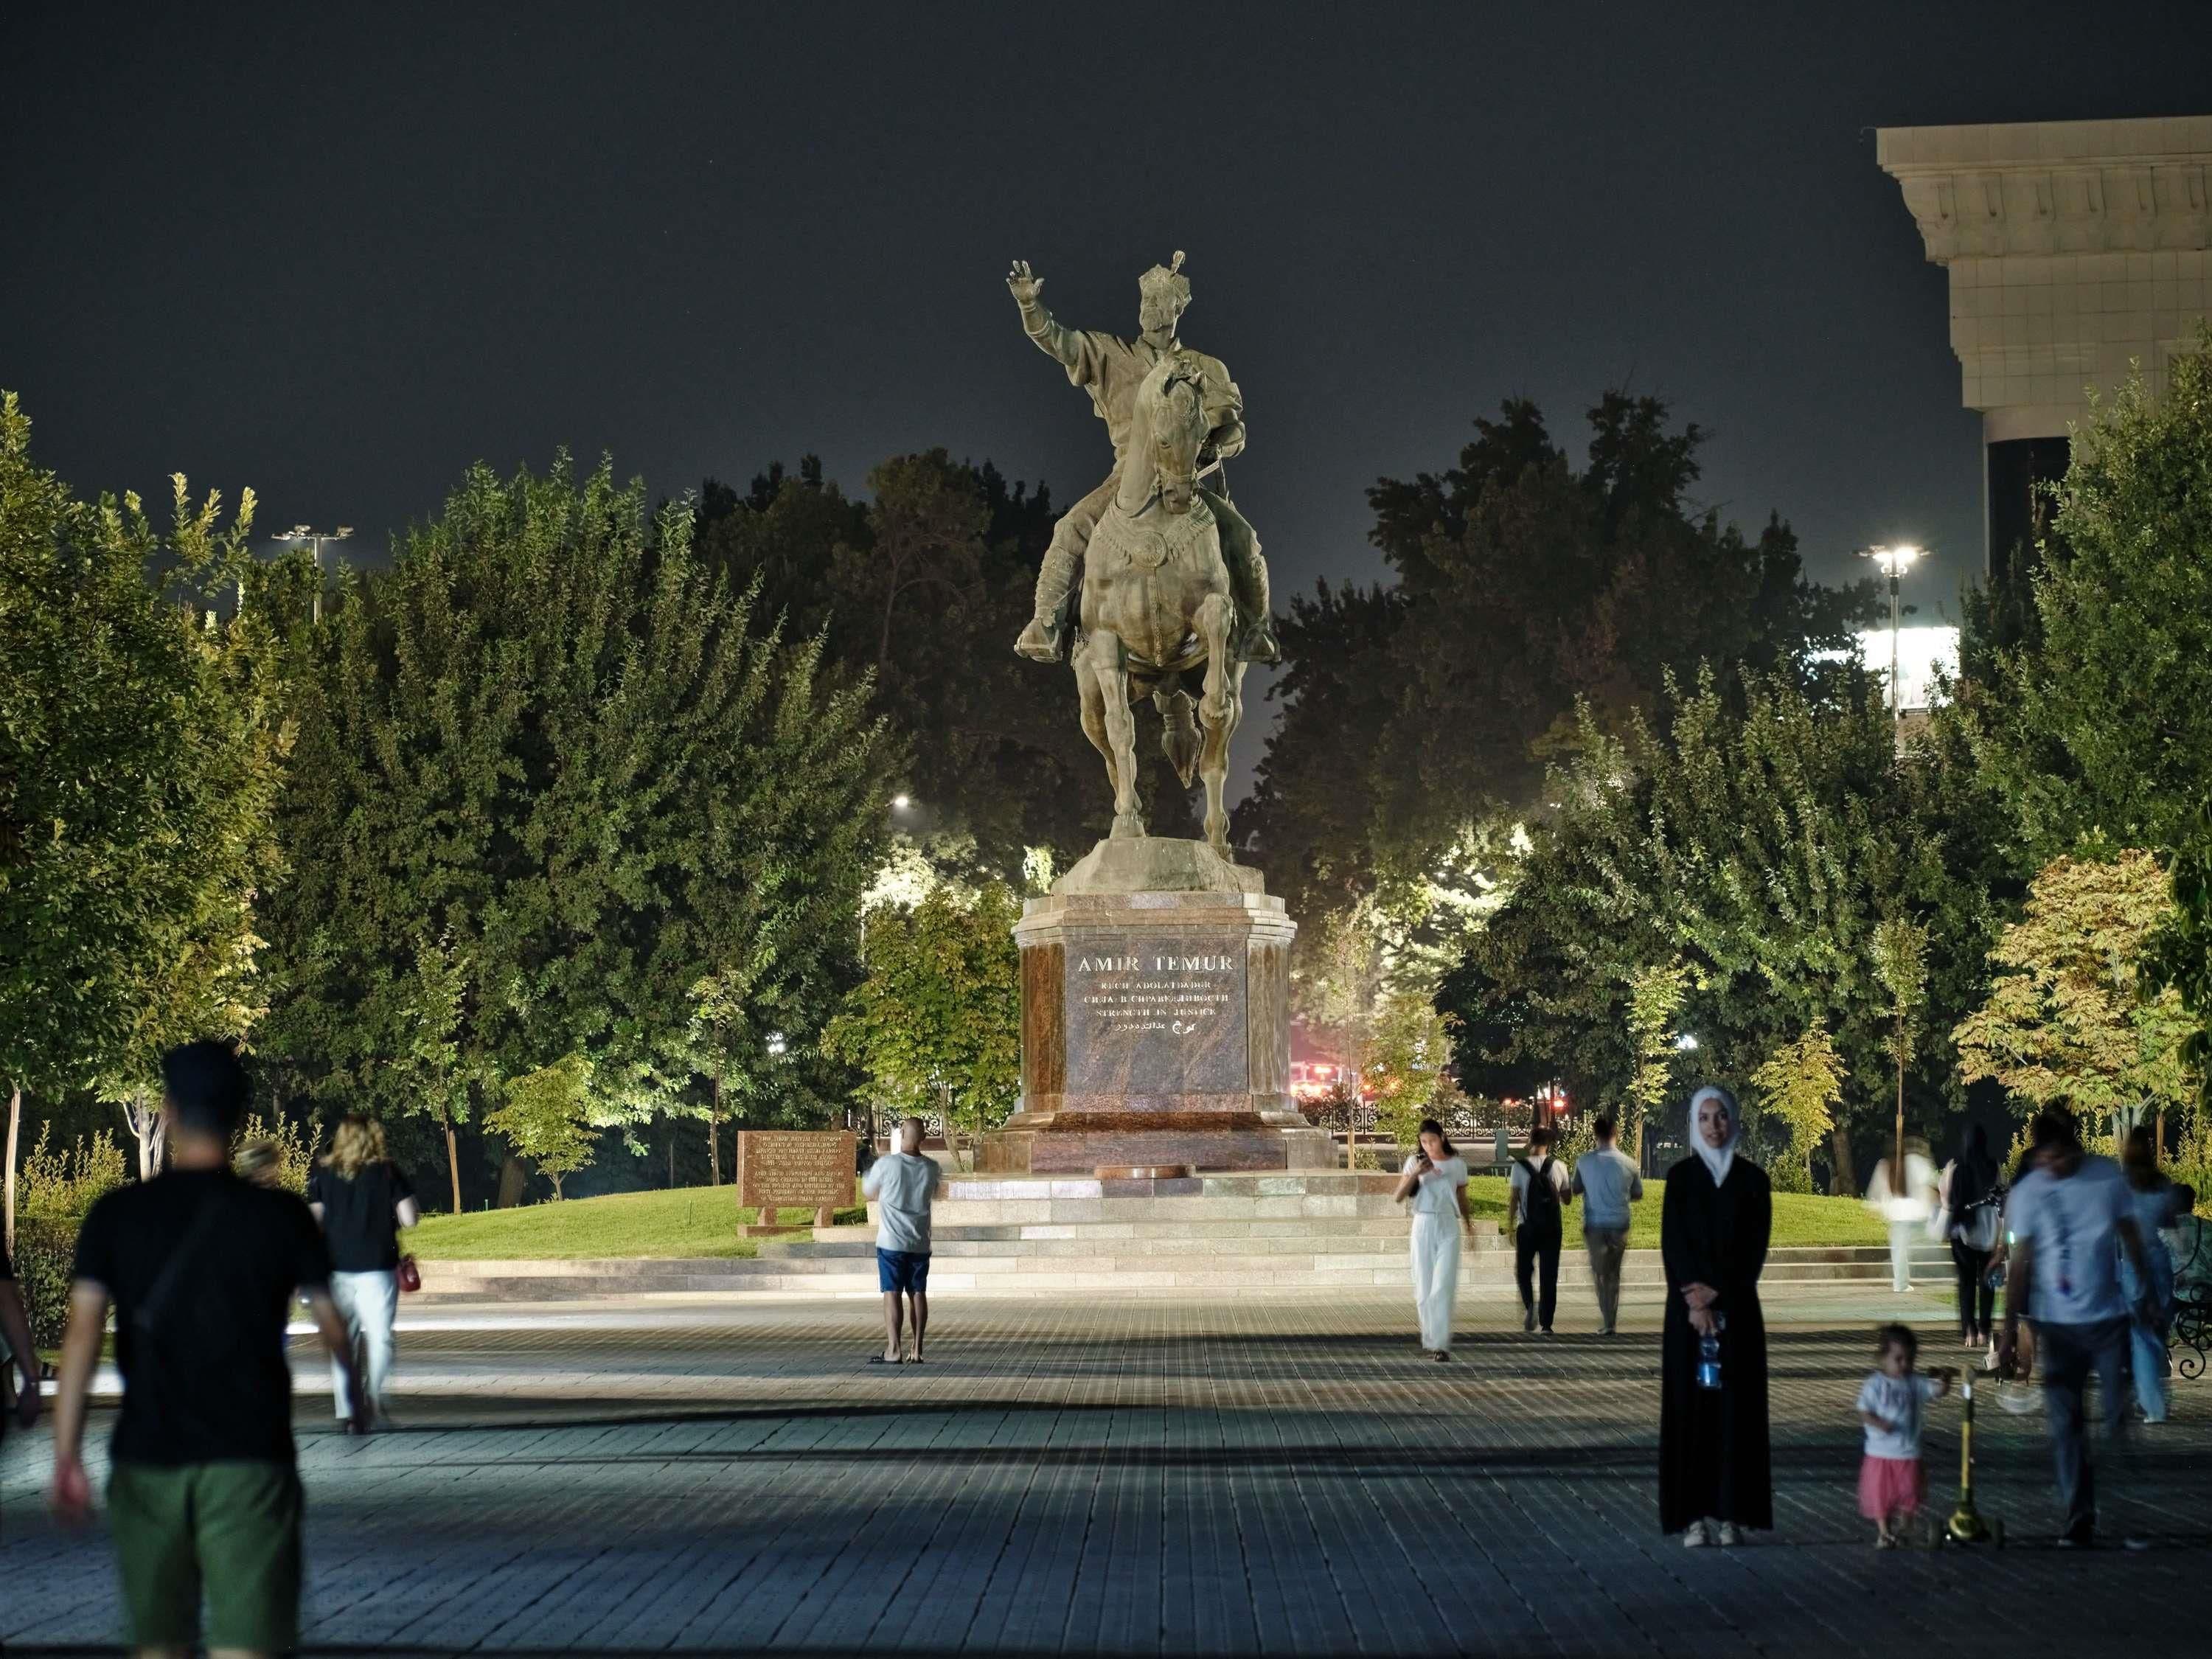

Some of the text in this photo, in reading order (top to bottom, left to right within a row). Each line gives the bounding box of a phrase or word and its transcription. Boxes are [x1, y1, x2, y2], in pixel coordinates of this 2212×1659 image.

[1078, 956, 1234, 972] AMIR TEMUR
[1096, 1009, 1150, 1017] STRENGTH
[1174, 1008, 1216, 1016] JUSTICE
